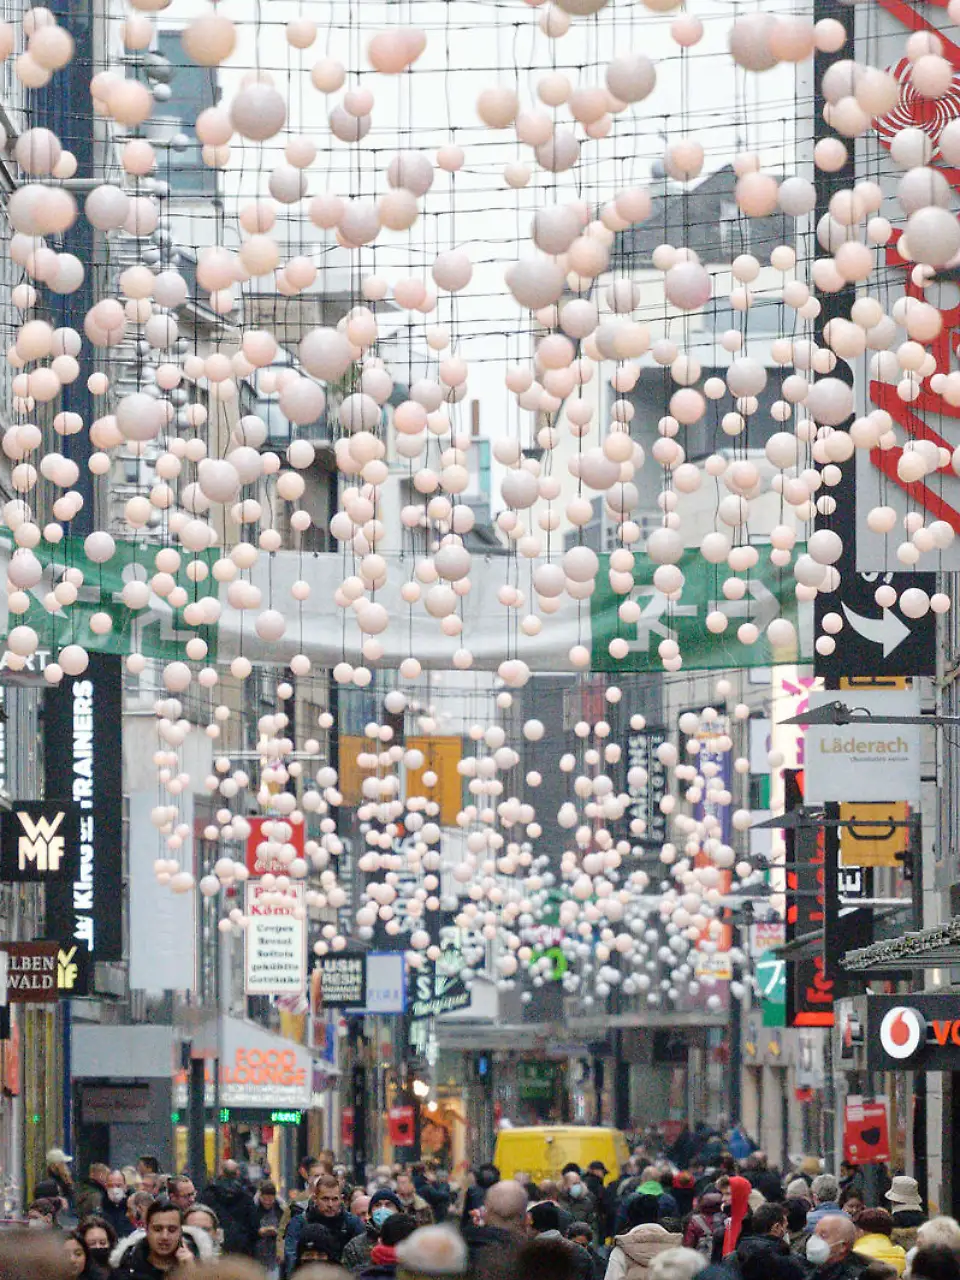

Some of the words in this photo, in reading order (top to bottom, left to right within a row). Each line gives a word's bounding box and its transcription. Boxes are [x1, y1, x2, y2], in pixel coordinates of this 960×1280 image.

[820, 736, 909, 754] Läderach
[16, 811, 66, 871] WMF
[9, 956, 54, 971] LBEN
[235, 1048, 297, 1068] FOOD
[225, 1065, 307, 1086] LOUNGE
